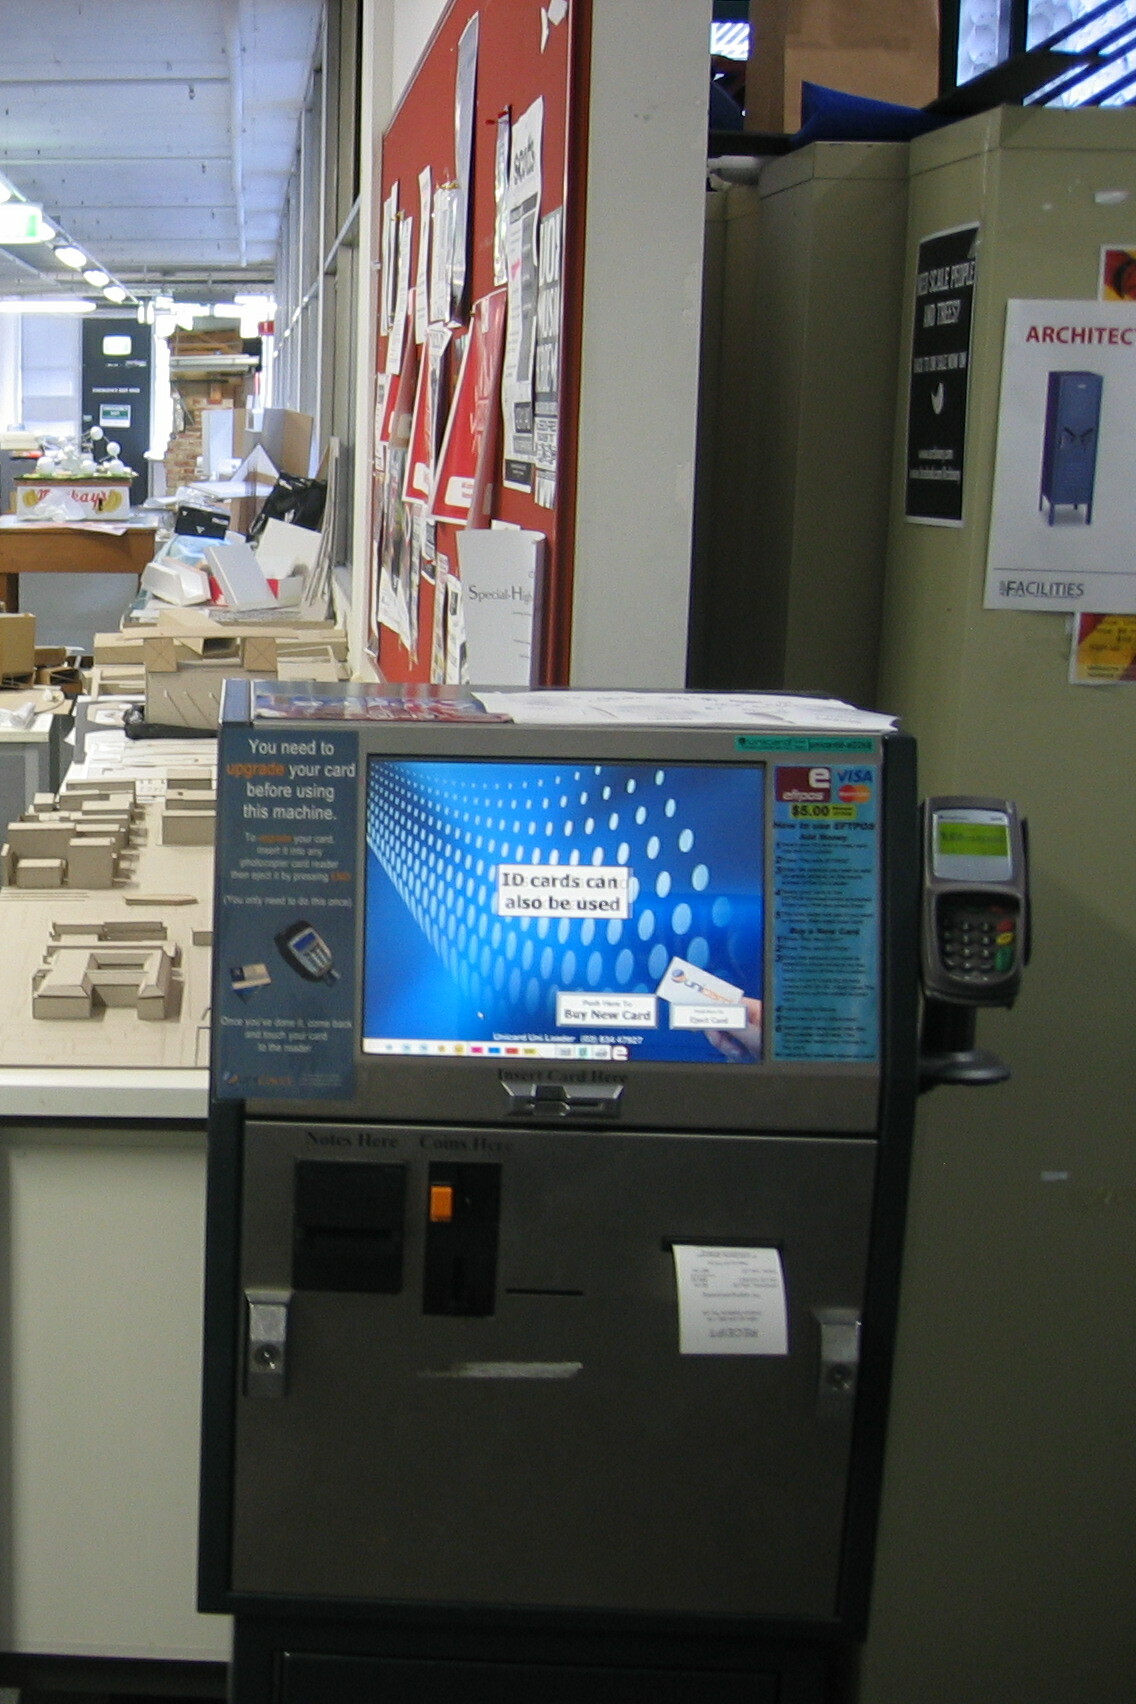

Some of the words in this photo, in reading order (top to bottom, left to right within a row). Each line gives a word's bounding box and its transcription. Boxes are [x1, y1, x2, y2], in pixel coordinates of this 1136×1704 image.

[1026, 325, 1136, 346] ARCHITEC
[1005, 579, 1085, 598] FACILITIES
[247, 738, 277, 755] You
[280, 739, 317, 756] need
[320, 741, 335, 756] to
[288, 763, 321, 780] your
[324, 762, 357, 778] card
[837, 769, 874, 783] VISA
[246, 781, 292, 798] before
[295, 783, 335, 802] using
[242, 802, 269, 819] this
[272, 803, 337, 820] machine.
[791, 804, 830, 818] $5.00
[501, 872, 525, 888] ID
[529, 873, 581, 889] cards
[585, 876, 619, 890] can
[504, 893, 543, 910] also
[548, 895, 572, 911] be
[576, 896, 621, 912] used
[564, 1008, 588, 1021] Buy
[591, 1009, 619, 1020] New
[621, 1010, 652, 1021] Card
[497, 1067, 543, 1082] Insert
[547, 1069, 587, 1083] Card
[591, 1070, 628, 1084] Here
[305, 1131, 352, 1148] Notes
[358, 1133, 398, 1149] Here
[419, 1134, 466, 1150] Coins
